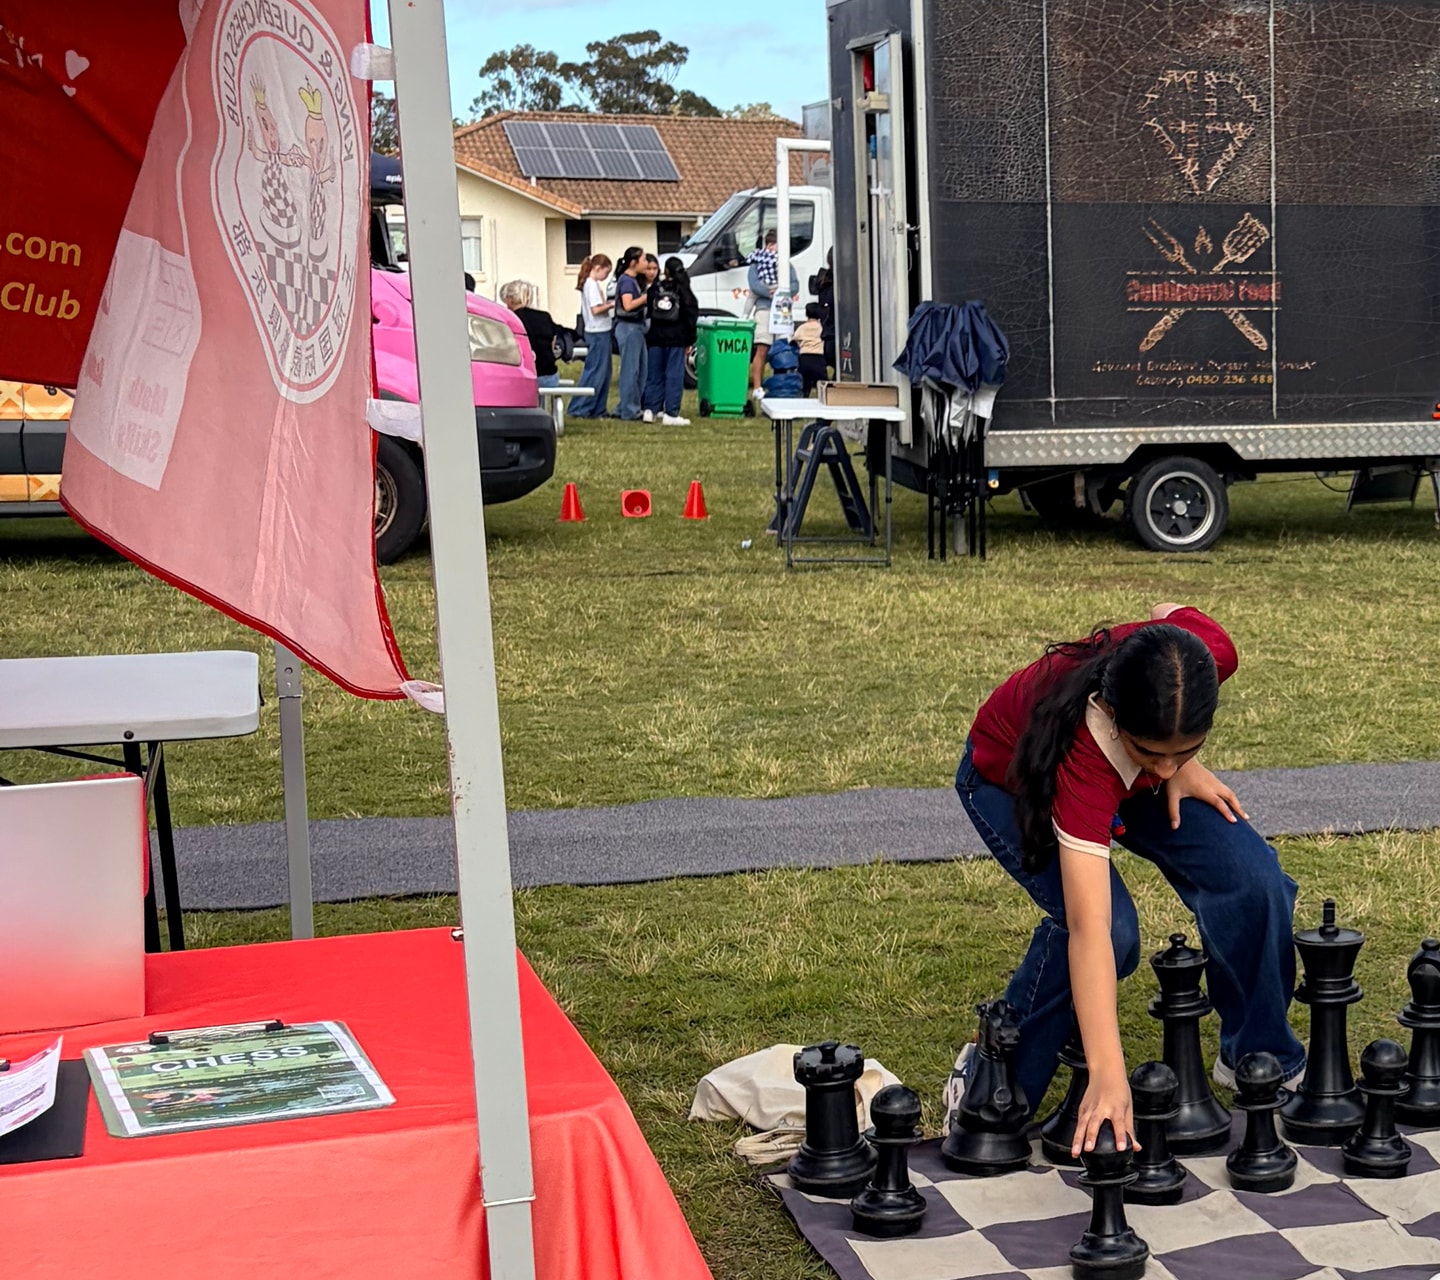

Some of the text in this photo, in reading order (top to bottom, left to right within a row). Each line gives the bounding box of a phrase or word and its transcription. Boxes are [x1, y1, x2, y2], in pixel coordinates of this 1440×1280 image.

[0, 231, 82, 268] com
[0, 281, 81, 320] Club
[716, 337, 749, 354] YMCA
[1186, 375, 1219, 386] 0430
[1222, 375, 1246, 386] 236
[151, 1045, 309, 1072] CHESS
